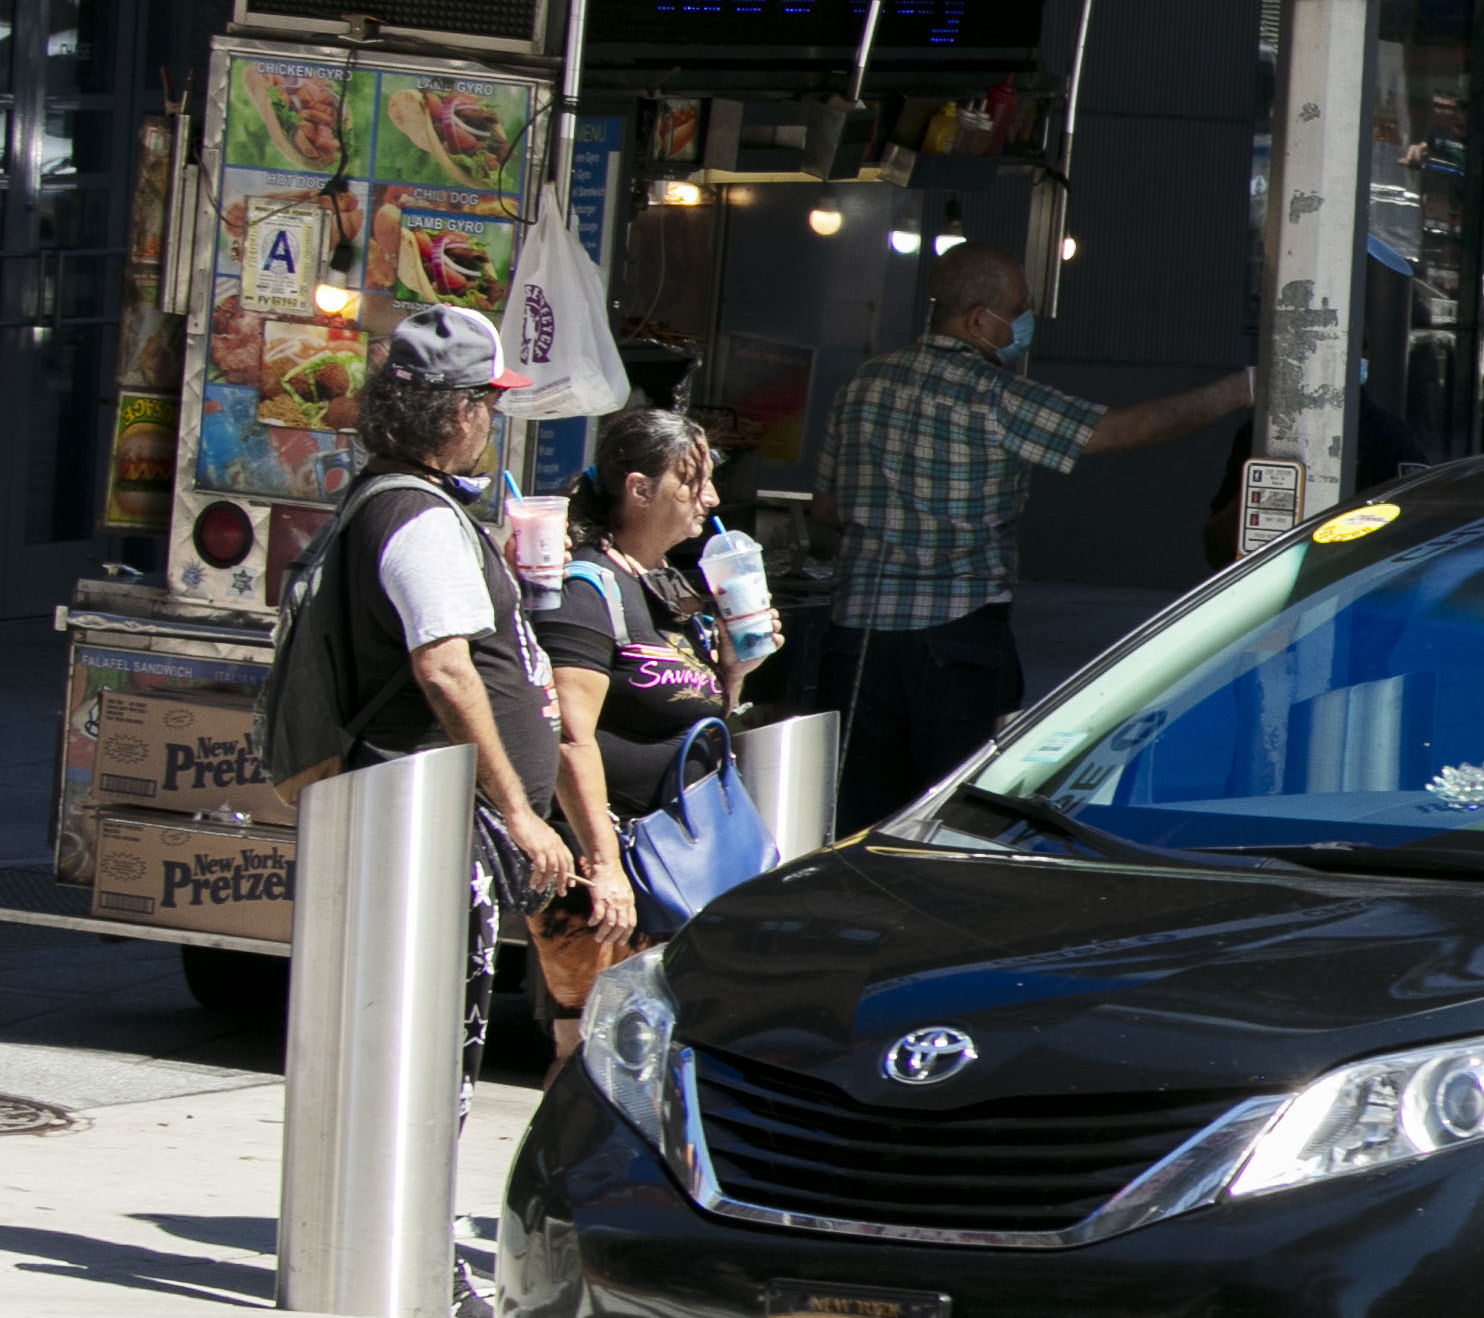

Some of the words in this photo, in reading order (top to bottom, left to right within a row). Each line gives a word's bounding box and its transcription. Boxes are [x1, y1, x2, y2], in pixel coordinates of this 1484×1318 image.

[256, 62, 313, 79] CHICKEN
[456, 81, 493, 96] GYRO
[266, 173, 294, 188] HOT
[296, 175, 327, 190] DOG
[450, 191, 479, 206] DOG
[406, 214, 443, 231] LAMB
[445, 217, 485, 234] GYRO
[262, 230, 296, 274] A
[81, 655, 129, 671] FALAFEL
[133, 661, 193, 679] SANDWICH
[196, 736, 238, 760] New
[193, 853, 236, 877] New
[239, 846, 287, 872] York
